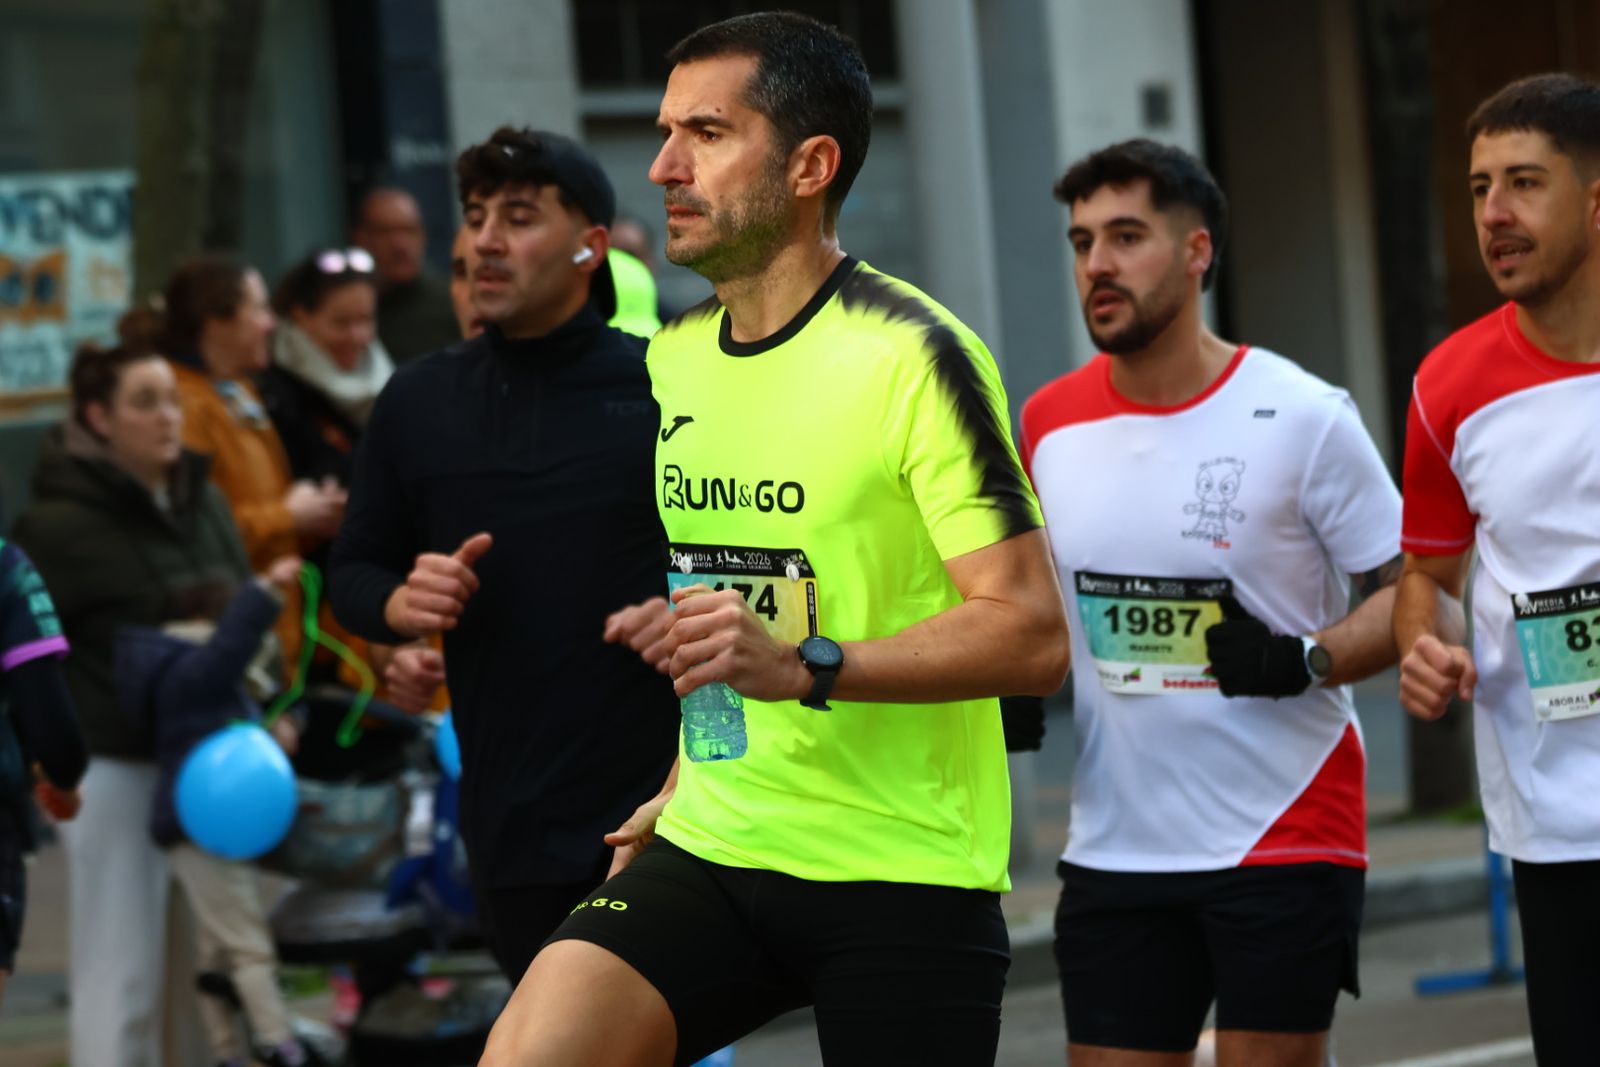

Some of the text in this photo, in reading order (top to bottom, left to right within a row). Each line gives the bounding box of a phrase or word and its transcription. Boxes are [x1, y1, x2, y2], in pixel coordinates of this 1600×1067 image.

[663, 464, 805, 514] RUN&GO
[744, 551, 771, 565] 2026
[713, 582, 778, 621] 74
[1104, 604, 1202, 638] 1987
